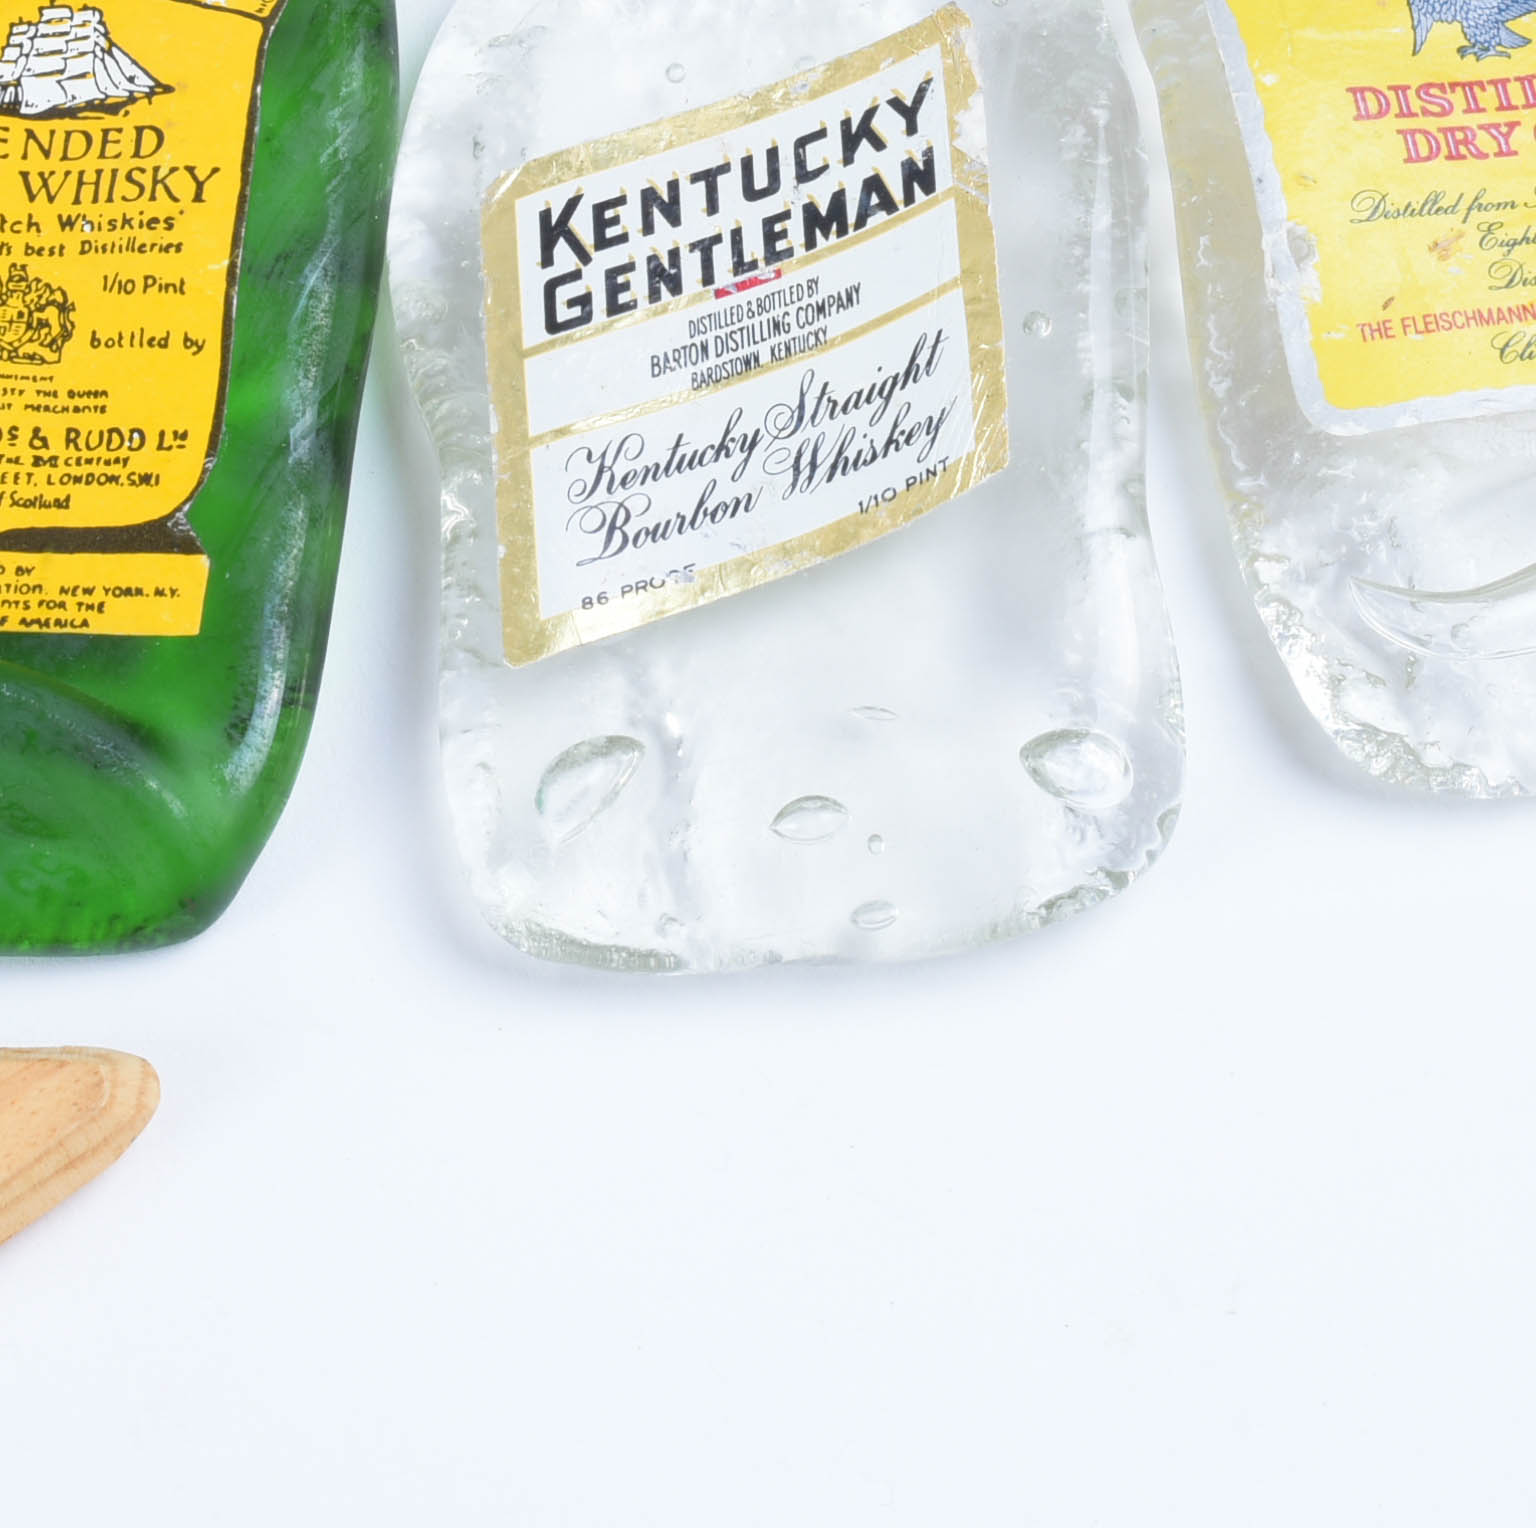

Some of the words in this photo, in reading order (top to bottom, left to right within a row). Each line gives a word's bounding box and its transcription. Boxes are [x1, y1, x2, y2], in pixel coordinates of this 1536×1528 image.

[1395, 120, 1522, 164] DRY
[17, 165, 221, 206] WHISKY
[538, 77, 932, 269] KENTUCKY
[1349, 189, 1462, 224] Distilled
[1457, 187, 1520, 224] from
[23, 241, 66, 258] best
[78, 237, 184, 256] Distilleries
[545, 145, 936, 336] GENTLEMAN
[102, 271, 137, 296] 1/10
[142, 274, 186, 296] Pint
[688, 303, 744, 340] DISTILLED
[746, 300, 756, 320] &
[755, 282, 805, 317] BOTTLED
[806, 275, 820, 298] BY
[89, 330, 171, 350] bottled
[182, 331, 207, 357] by
[650, 338, 710, 379] BARTON
[713, 310, 792, 359] DISTILLING
[795, 281, 861, 330] COMPANY
[769, 325, 833, 365] KENTUCKY
[1356, 318, 1395, 343] THE
[565, 408, 761, 499] Kentucky
[764, 329, 949, 451] Straight
[28, 425, 50, 451] &
[64, 426, 147, 453] RUDD
[8, 489, 71, 511] Scotland
[566, 478, 762, 566] Bourbon
[762, 395, 956, 498] Whiskey
[857, 487, 900, 516] 1/10
[905, 455, 950, 493] PINT
[581, 590, 610, 610] 86
